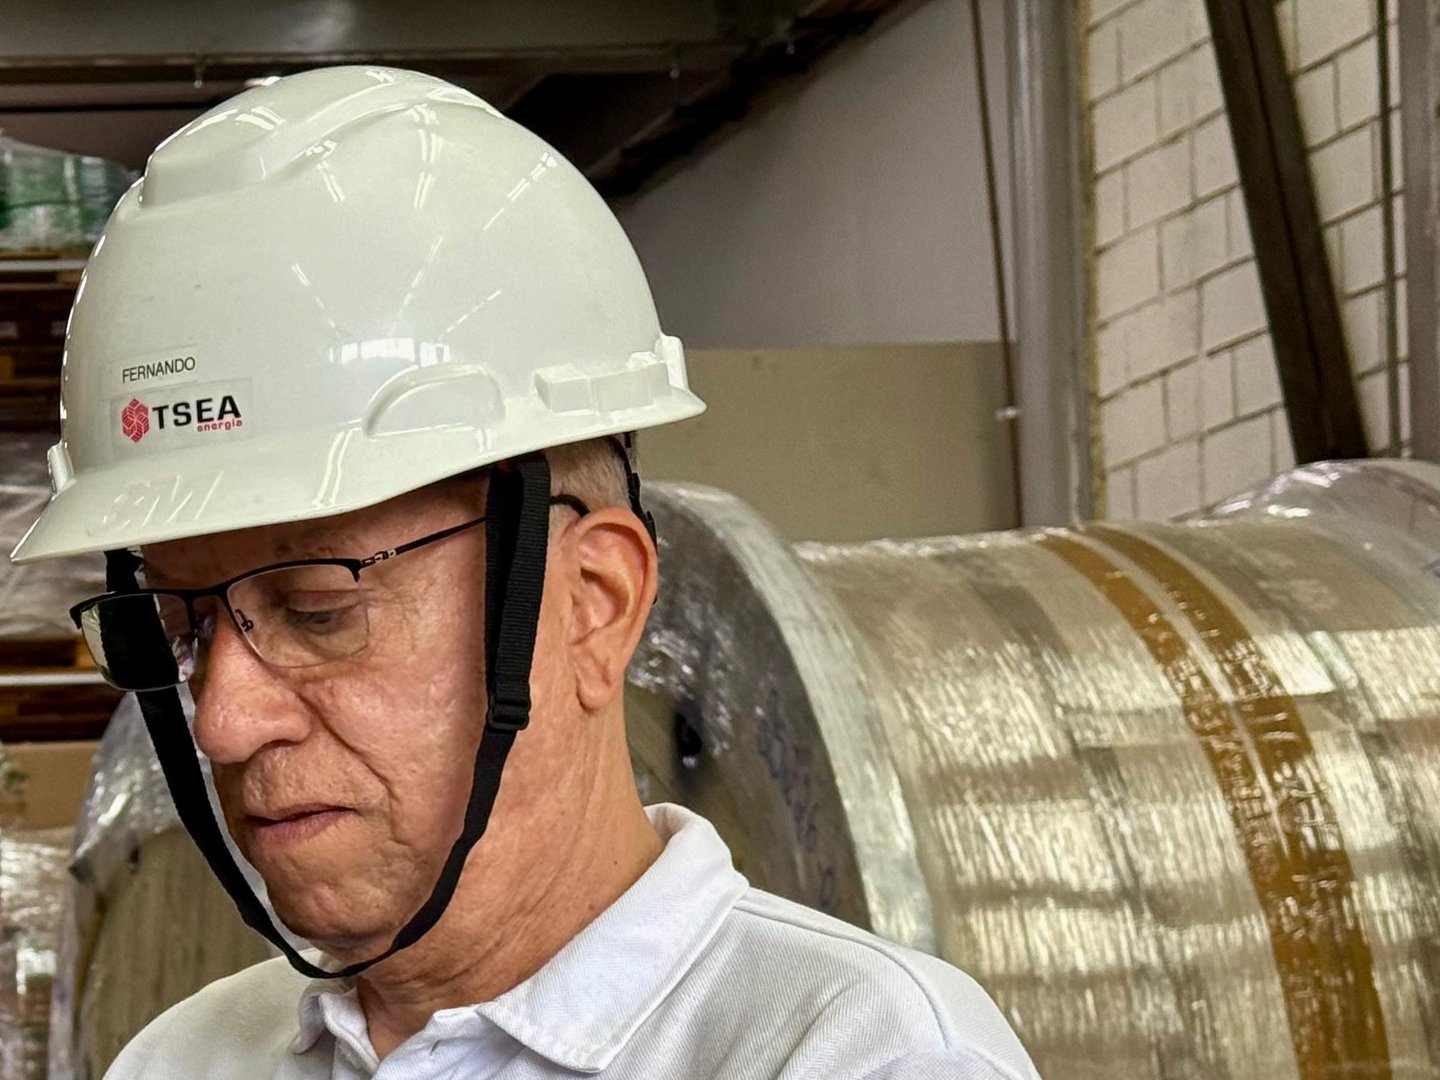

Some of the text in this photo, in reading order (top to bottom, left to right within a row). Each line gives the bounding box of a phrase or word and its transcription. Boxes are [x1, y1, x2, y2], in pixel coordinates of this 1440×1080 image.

[122, 356, 196, 384] FERNANDO
[152, 395, 242, 430] TSEA
[197, 419, 243, 433] energia
